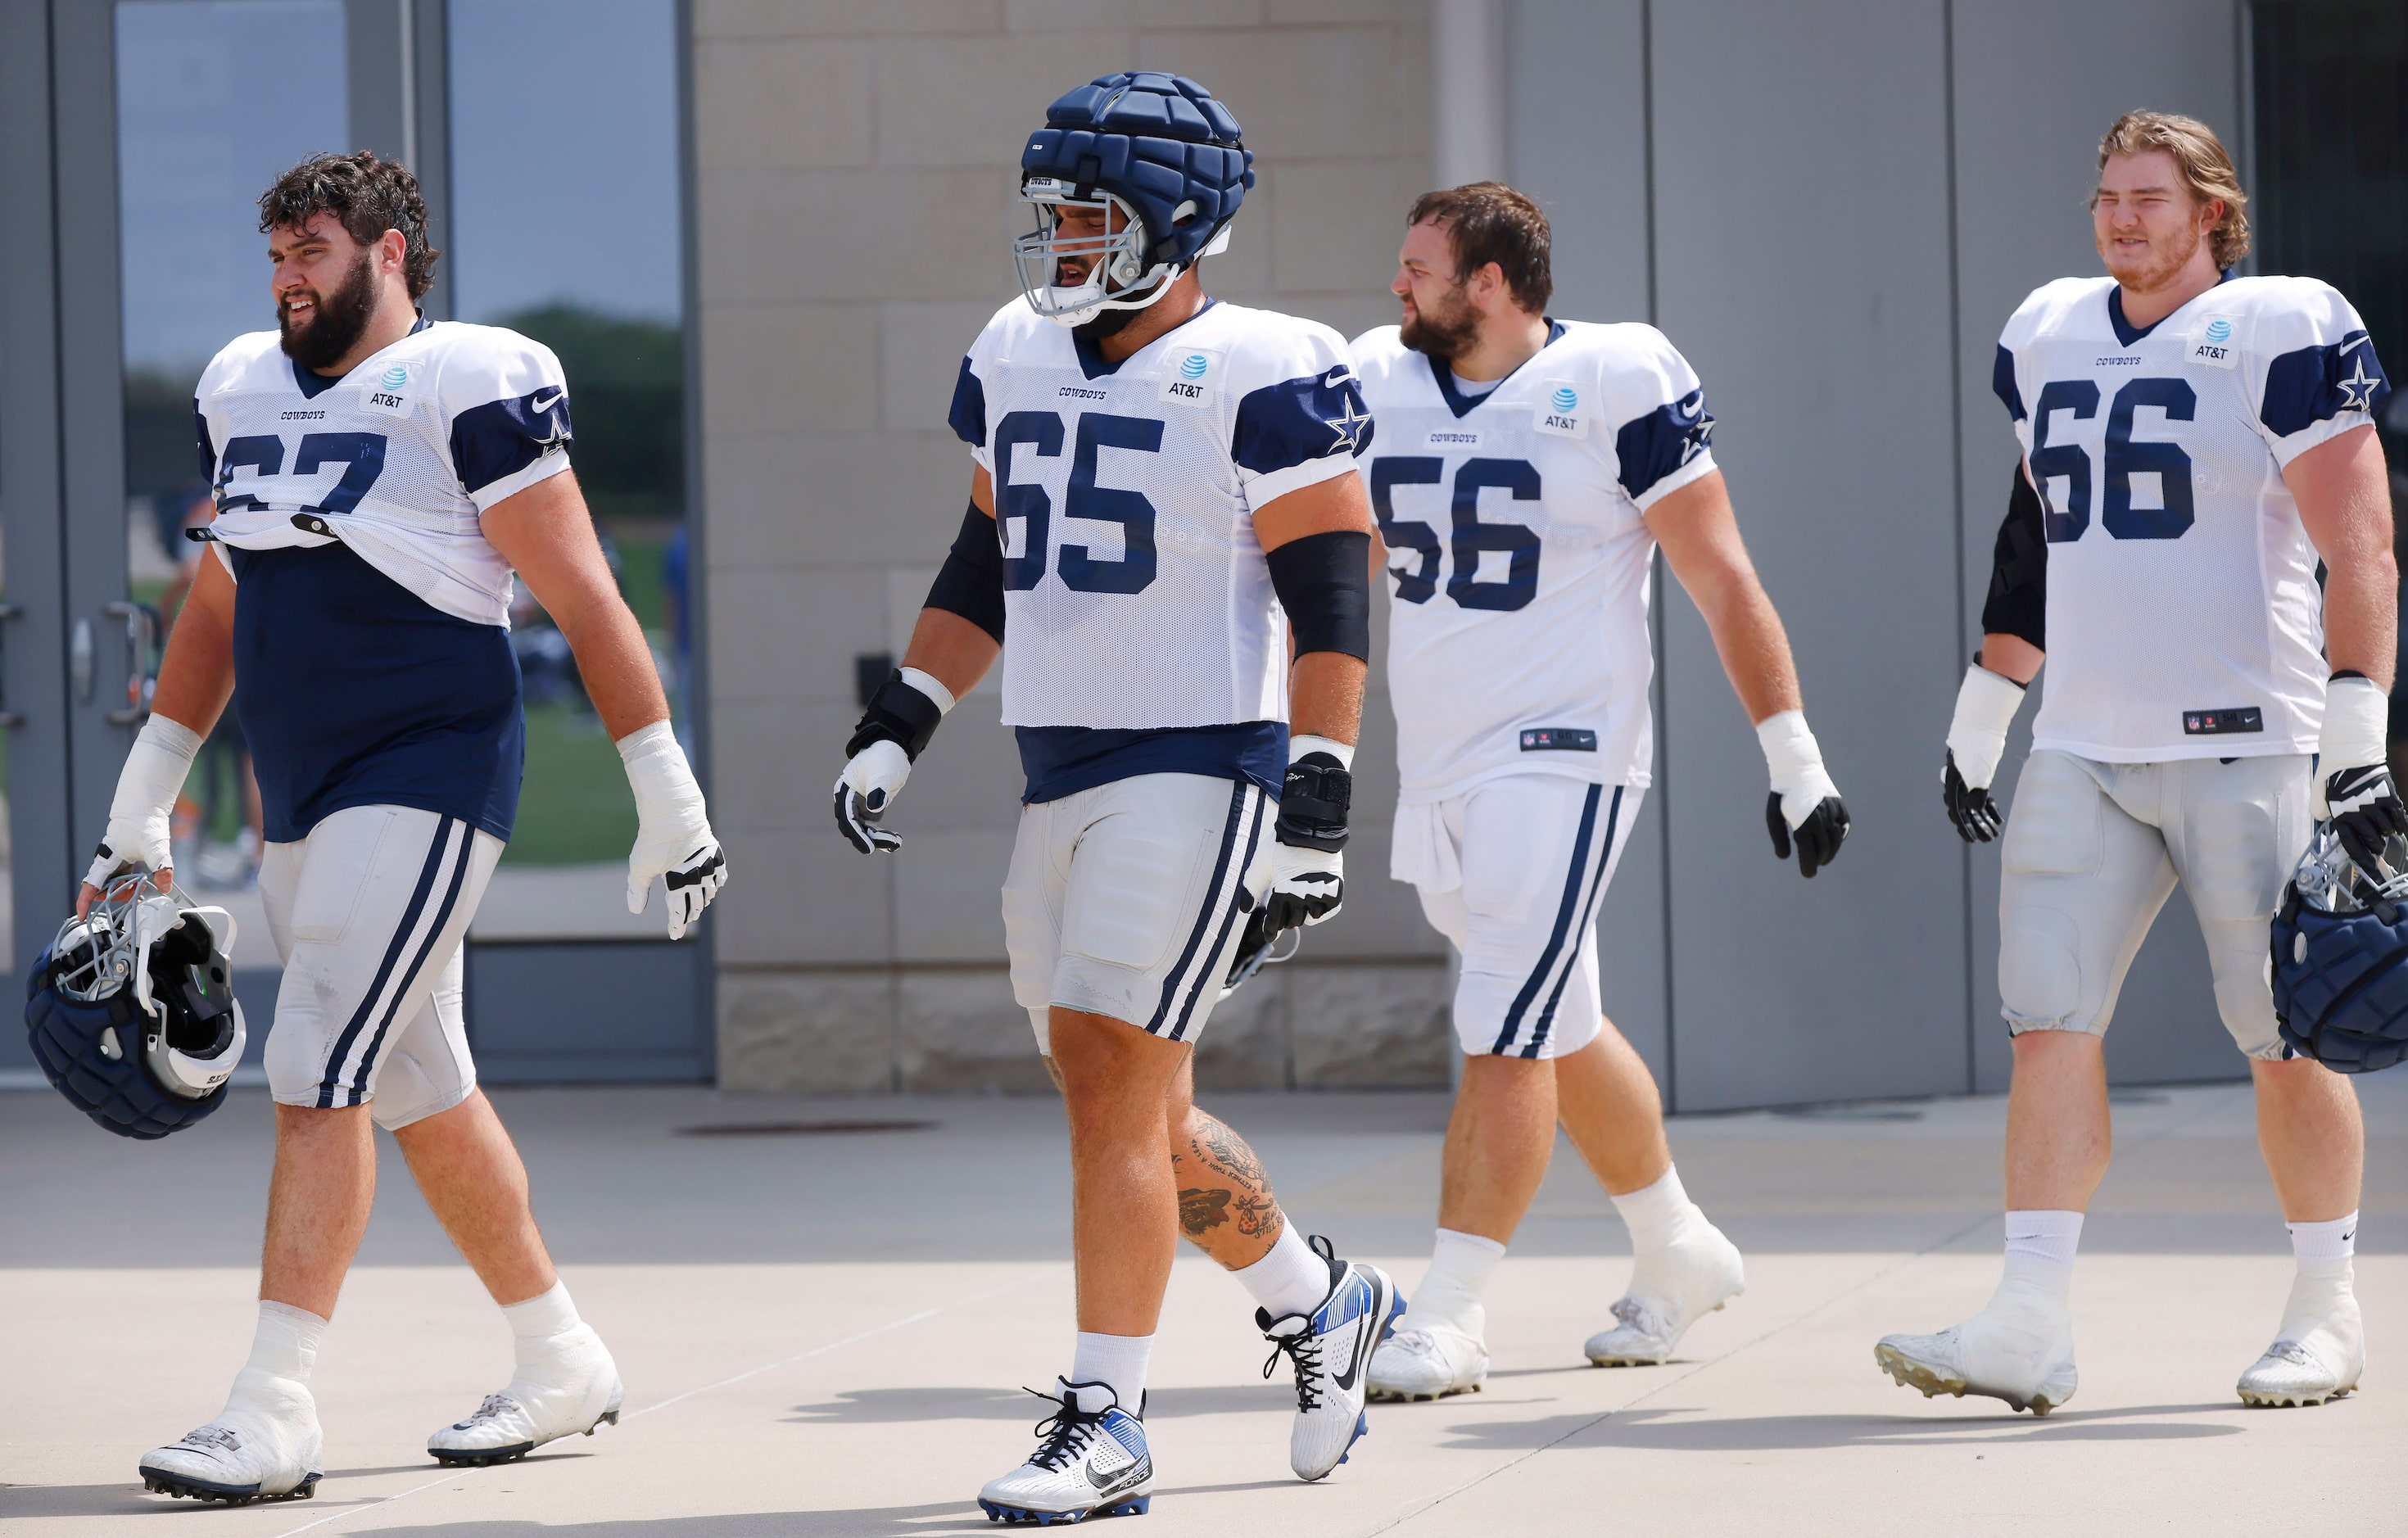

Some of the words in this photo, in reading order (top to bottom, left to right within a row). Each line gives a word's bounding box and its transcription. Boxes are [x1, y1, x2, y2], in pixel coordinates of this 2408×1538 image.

[2196, 346, 2228, 360] AT&T
[2096, 357, 2141, 366] COWBOYS
[1059, 387, 1106, 400] COWBOYS
[1169, 382, 1204, 398] AT&T
[370, 393, 403, 408] AT&T
[281, 411, 325, 420] COWBOYS
[1545, 415, 1577, 431] AT&T
[1431, 433, 1477, 443] COWBOYS
[2030, 378, 2197, 543] 66
[994, 410, 1165, 595] 65
[1370, 456, 1541, 611] 56
[1208, 1162, 1226, 1175] TOOK
[1228, 1172, 1252, 1190] EITHER
[1255, 1221, 1277, 1239] STILL
[1117, 1467, 1150, 1491] FORCE
